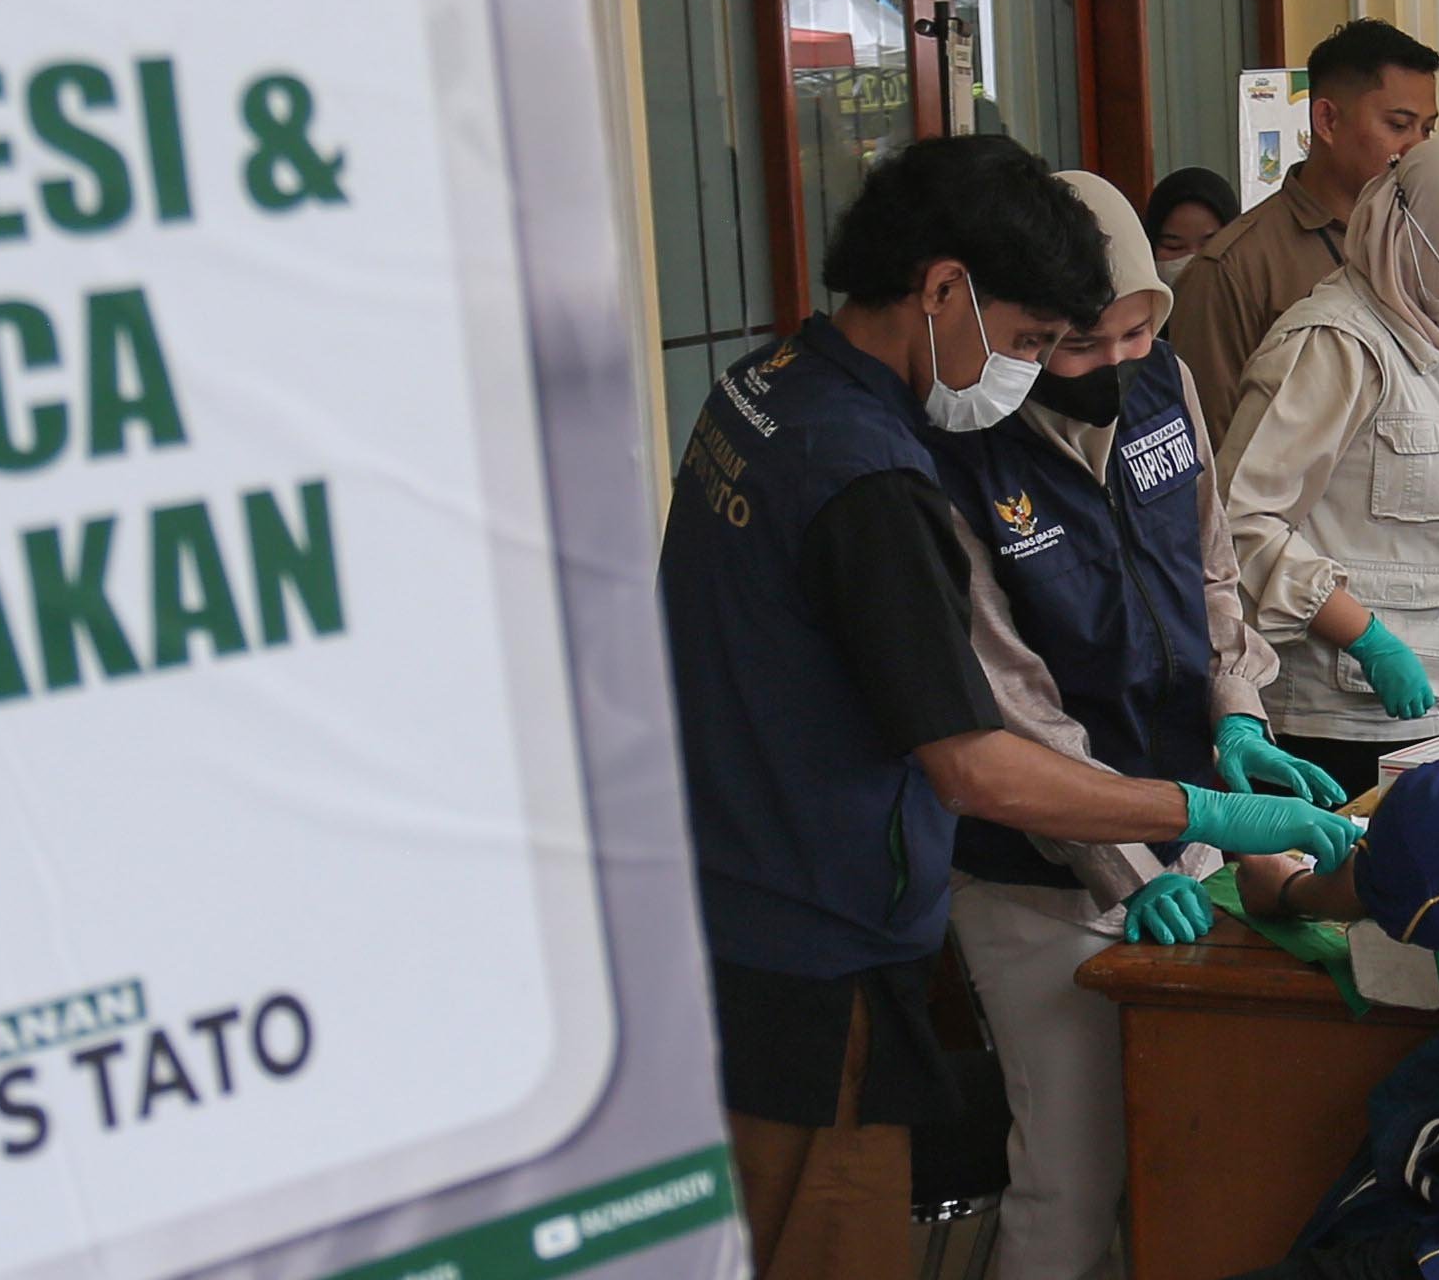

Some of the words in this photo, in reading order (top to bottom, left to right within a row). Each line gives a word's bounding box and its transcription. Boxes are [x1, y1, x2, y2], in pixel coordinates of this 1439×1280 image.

[238, 71, 350, 213] &
[1124, 442, 1144, 456] TIM
[1144, 420, 1184, 447] LAYANAN
[1127, 446, 1174, 493] HAPUS
[1165, 431, 1195, 474] TATO
[73, 992, 313, 1131] TATO
